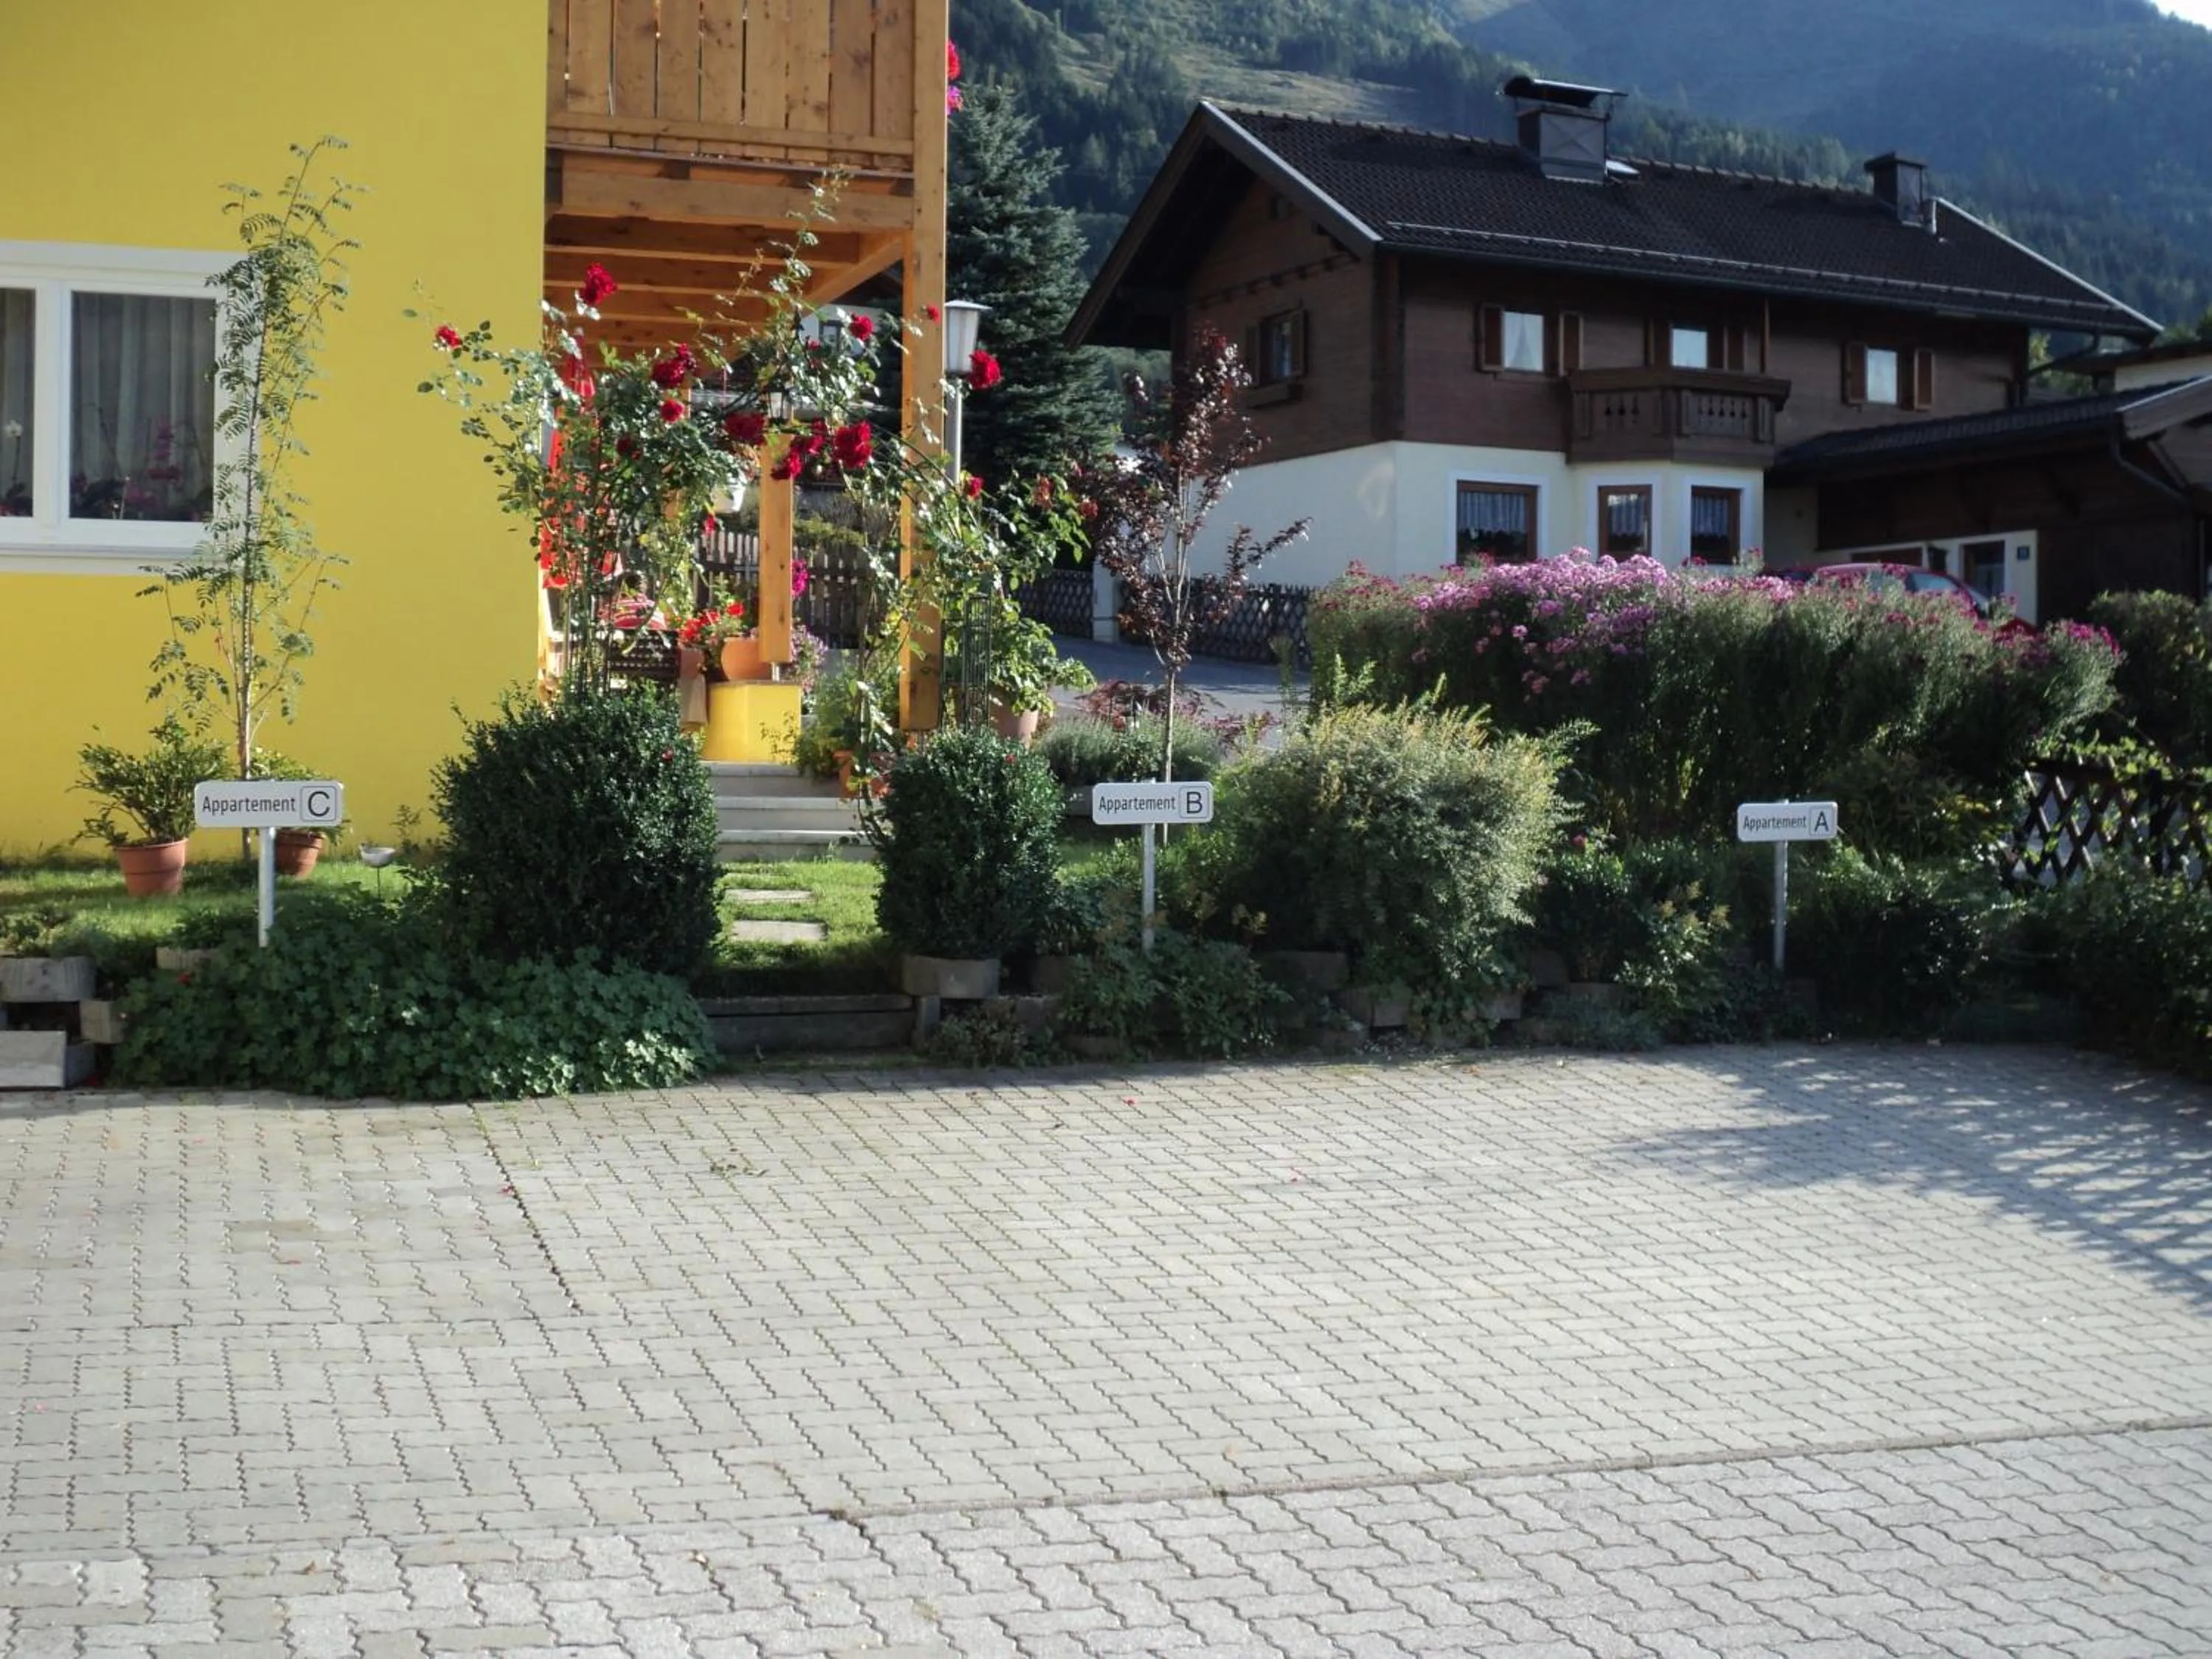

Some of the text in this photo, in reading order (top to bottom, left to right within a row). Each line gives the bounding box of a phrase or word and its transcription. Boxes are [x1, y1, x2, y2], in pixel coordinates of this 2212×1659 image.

[203, 790, 330, 817] Appartement C
[1099, 791, 1203, 814] Appartement B
[1743, 810, 1829, 832] Appartement A
